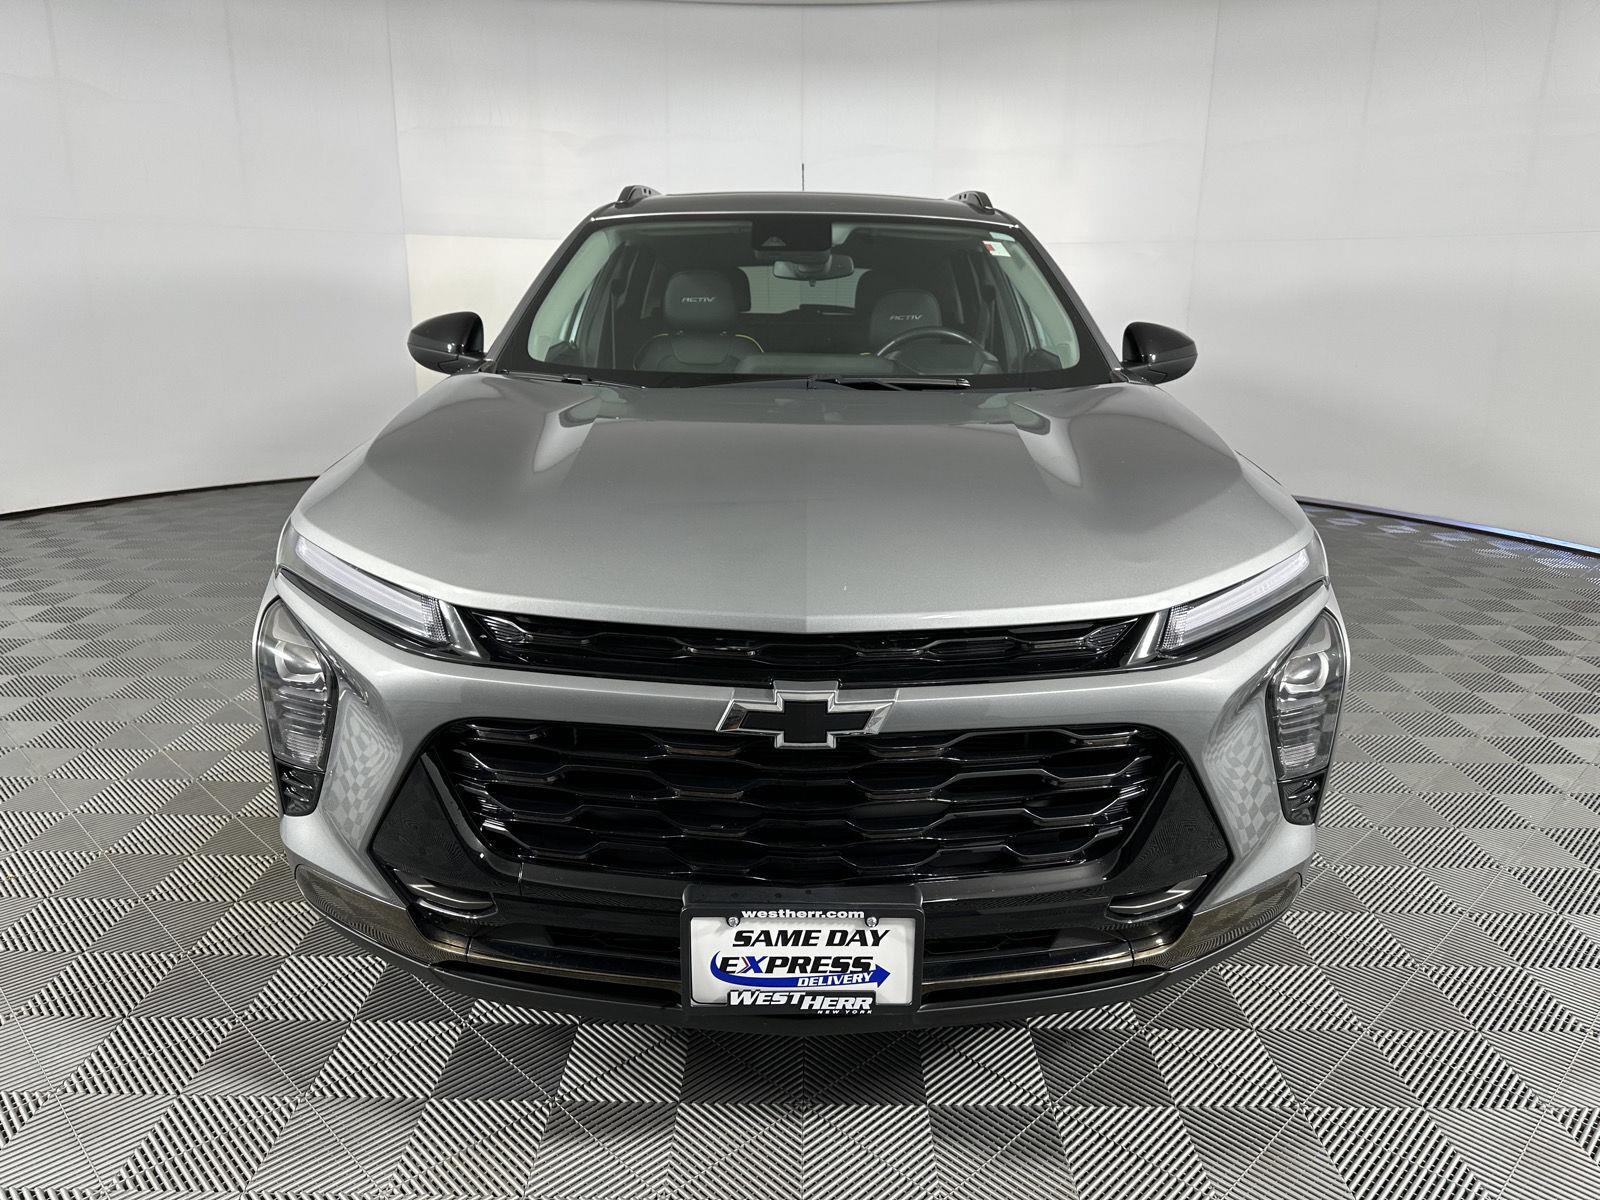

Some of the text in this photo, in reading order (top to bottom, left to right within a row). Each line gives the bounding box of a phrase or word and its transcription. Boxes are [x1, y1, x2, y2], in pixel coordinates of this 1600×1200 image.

[741, 909, 865, 919] westherr.com
[732, 929, 891, 947] SAME DAY
[719, 956, 874, 974] EXPRESS
[797, 971, 874, 987] DELIVERY
